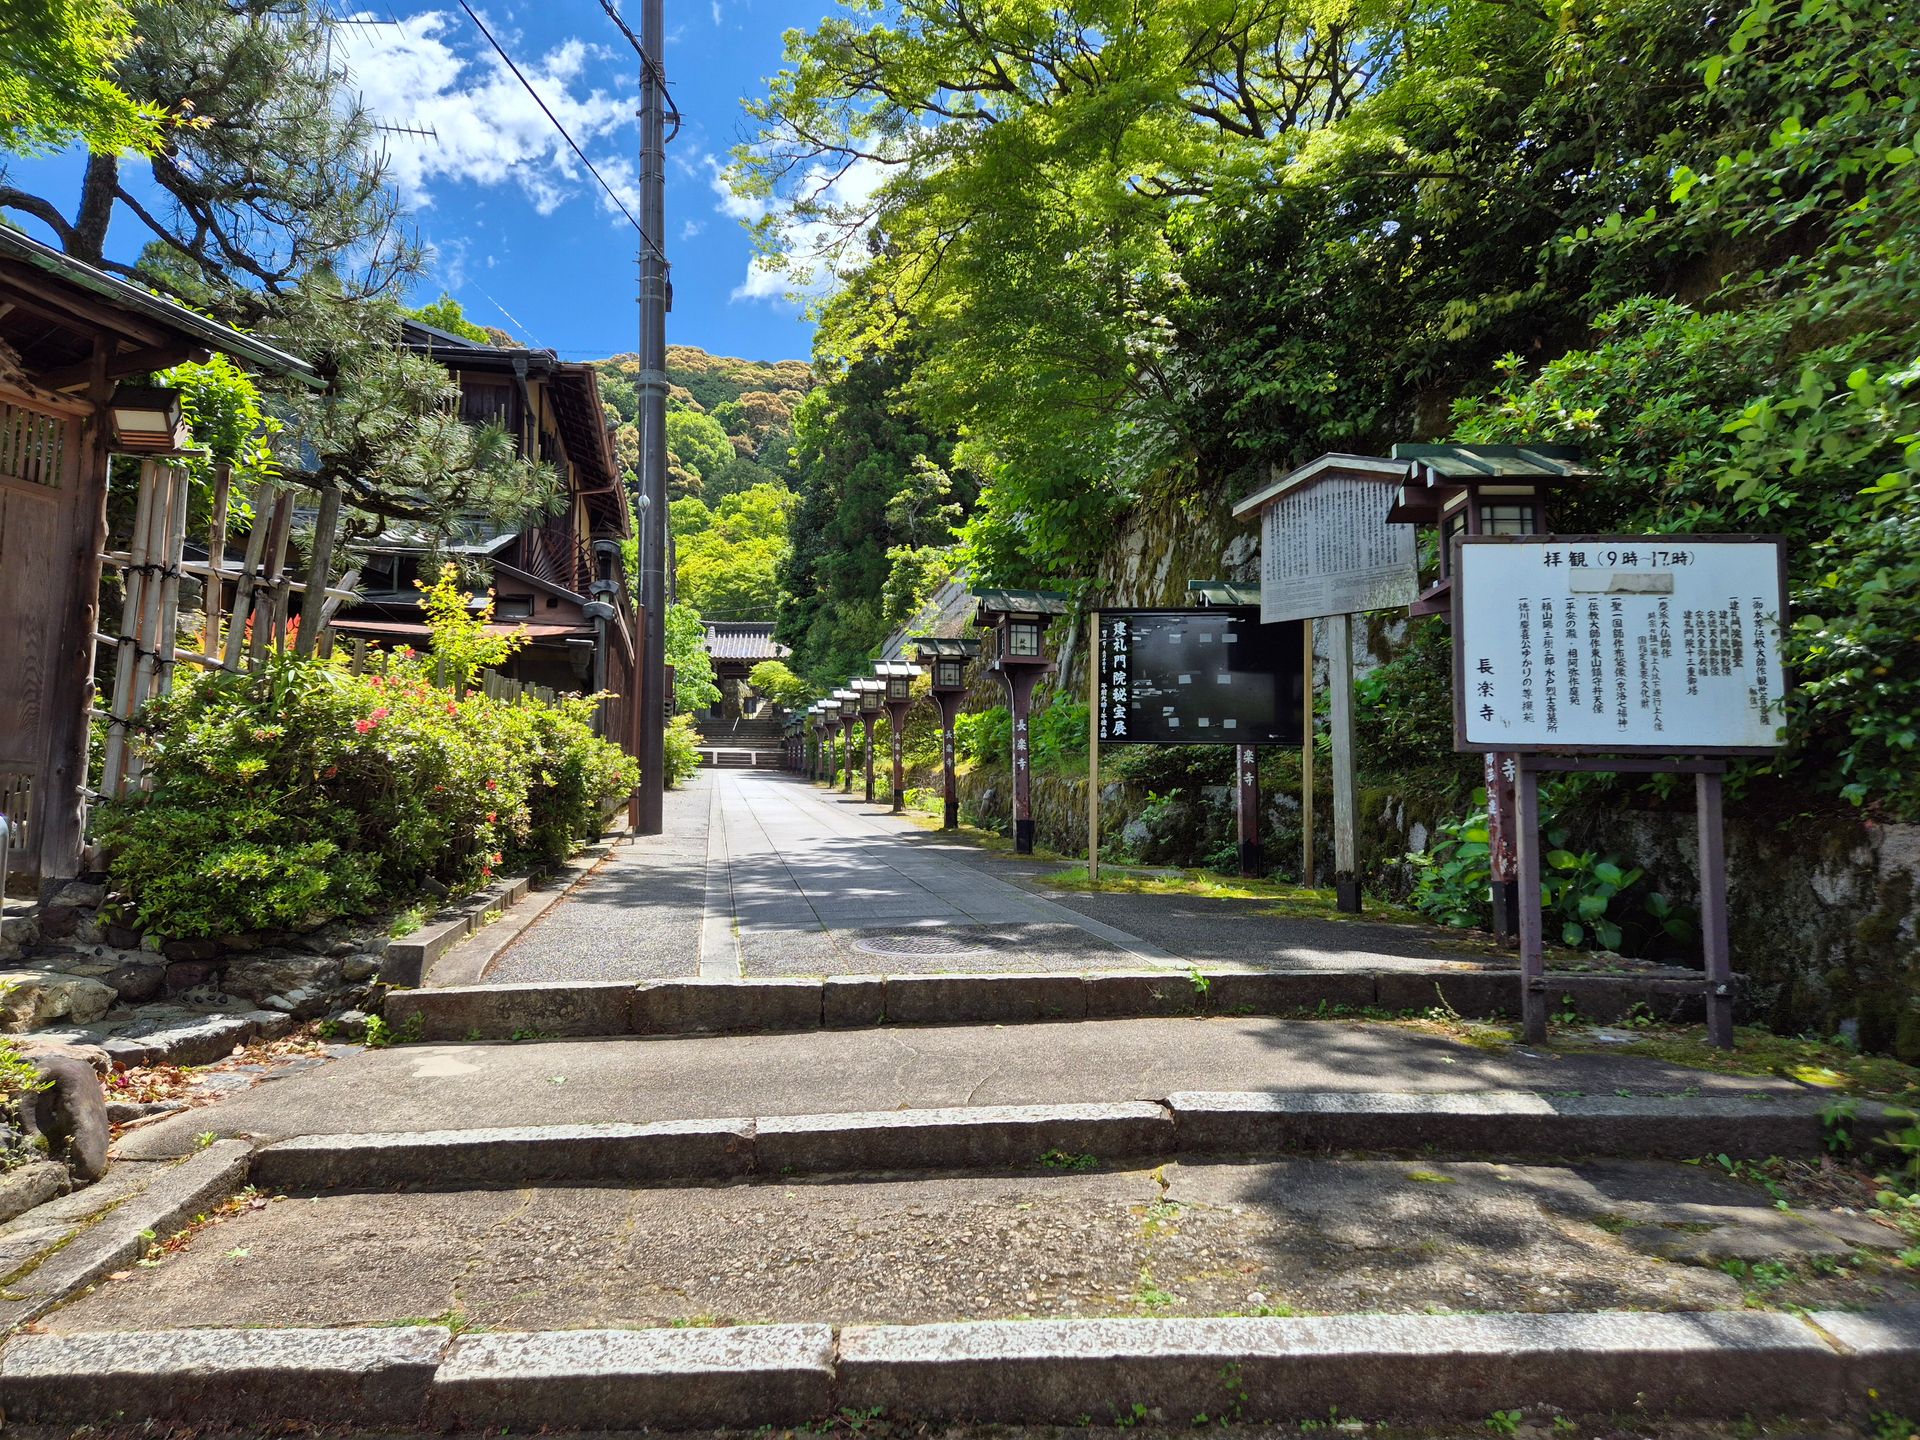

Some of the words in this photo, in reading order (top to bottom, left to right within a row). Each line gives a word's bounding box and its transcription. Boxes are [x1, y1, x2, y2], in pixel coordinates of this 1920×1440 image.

[1112, 621, 1128, 737] 建礼門院秘宝展
[1476, 658, 1495, 722] 長楽寺
[945, 730, 953, 768] 長楽寺
[1016, 718, 1028, 771] 長楽寺
